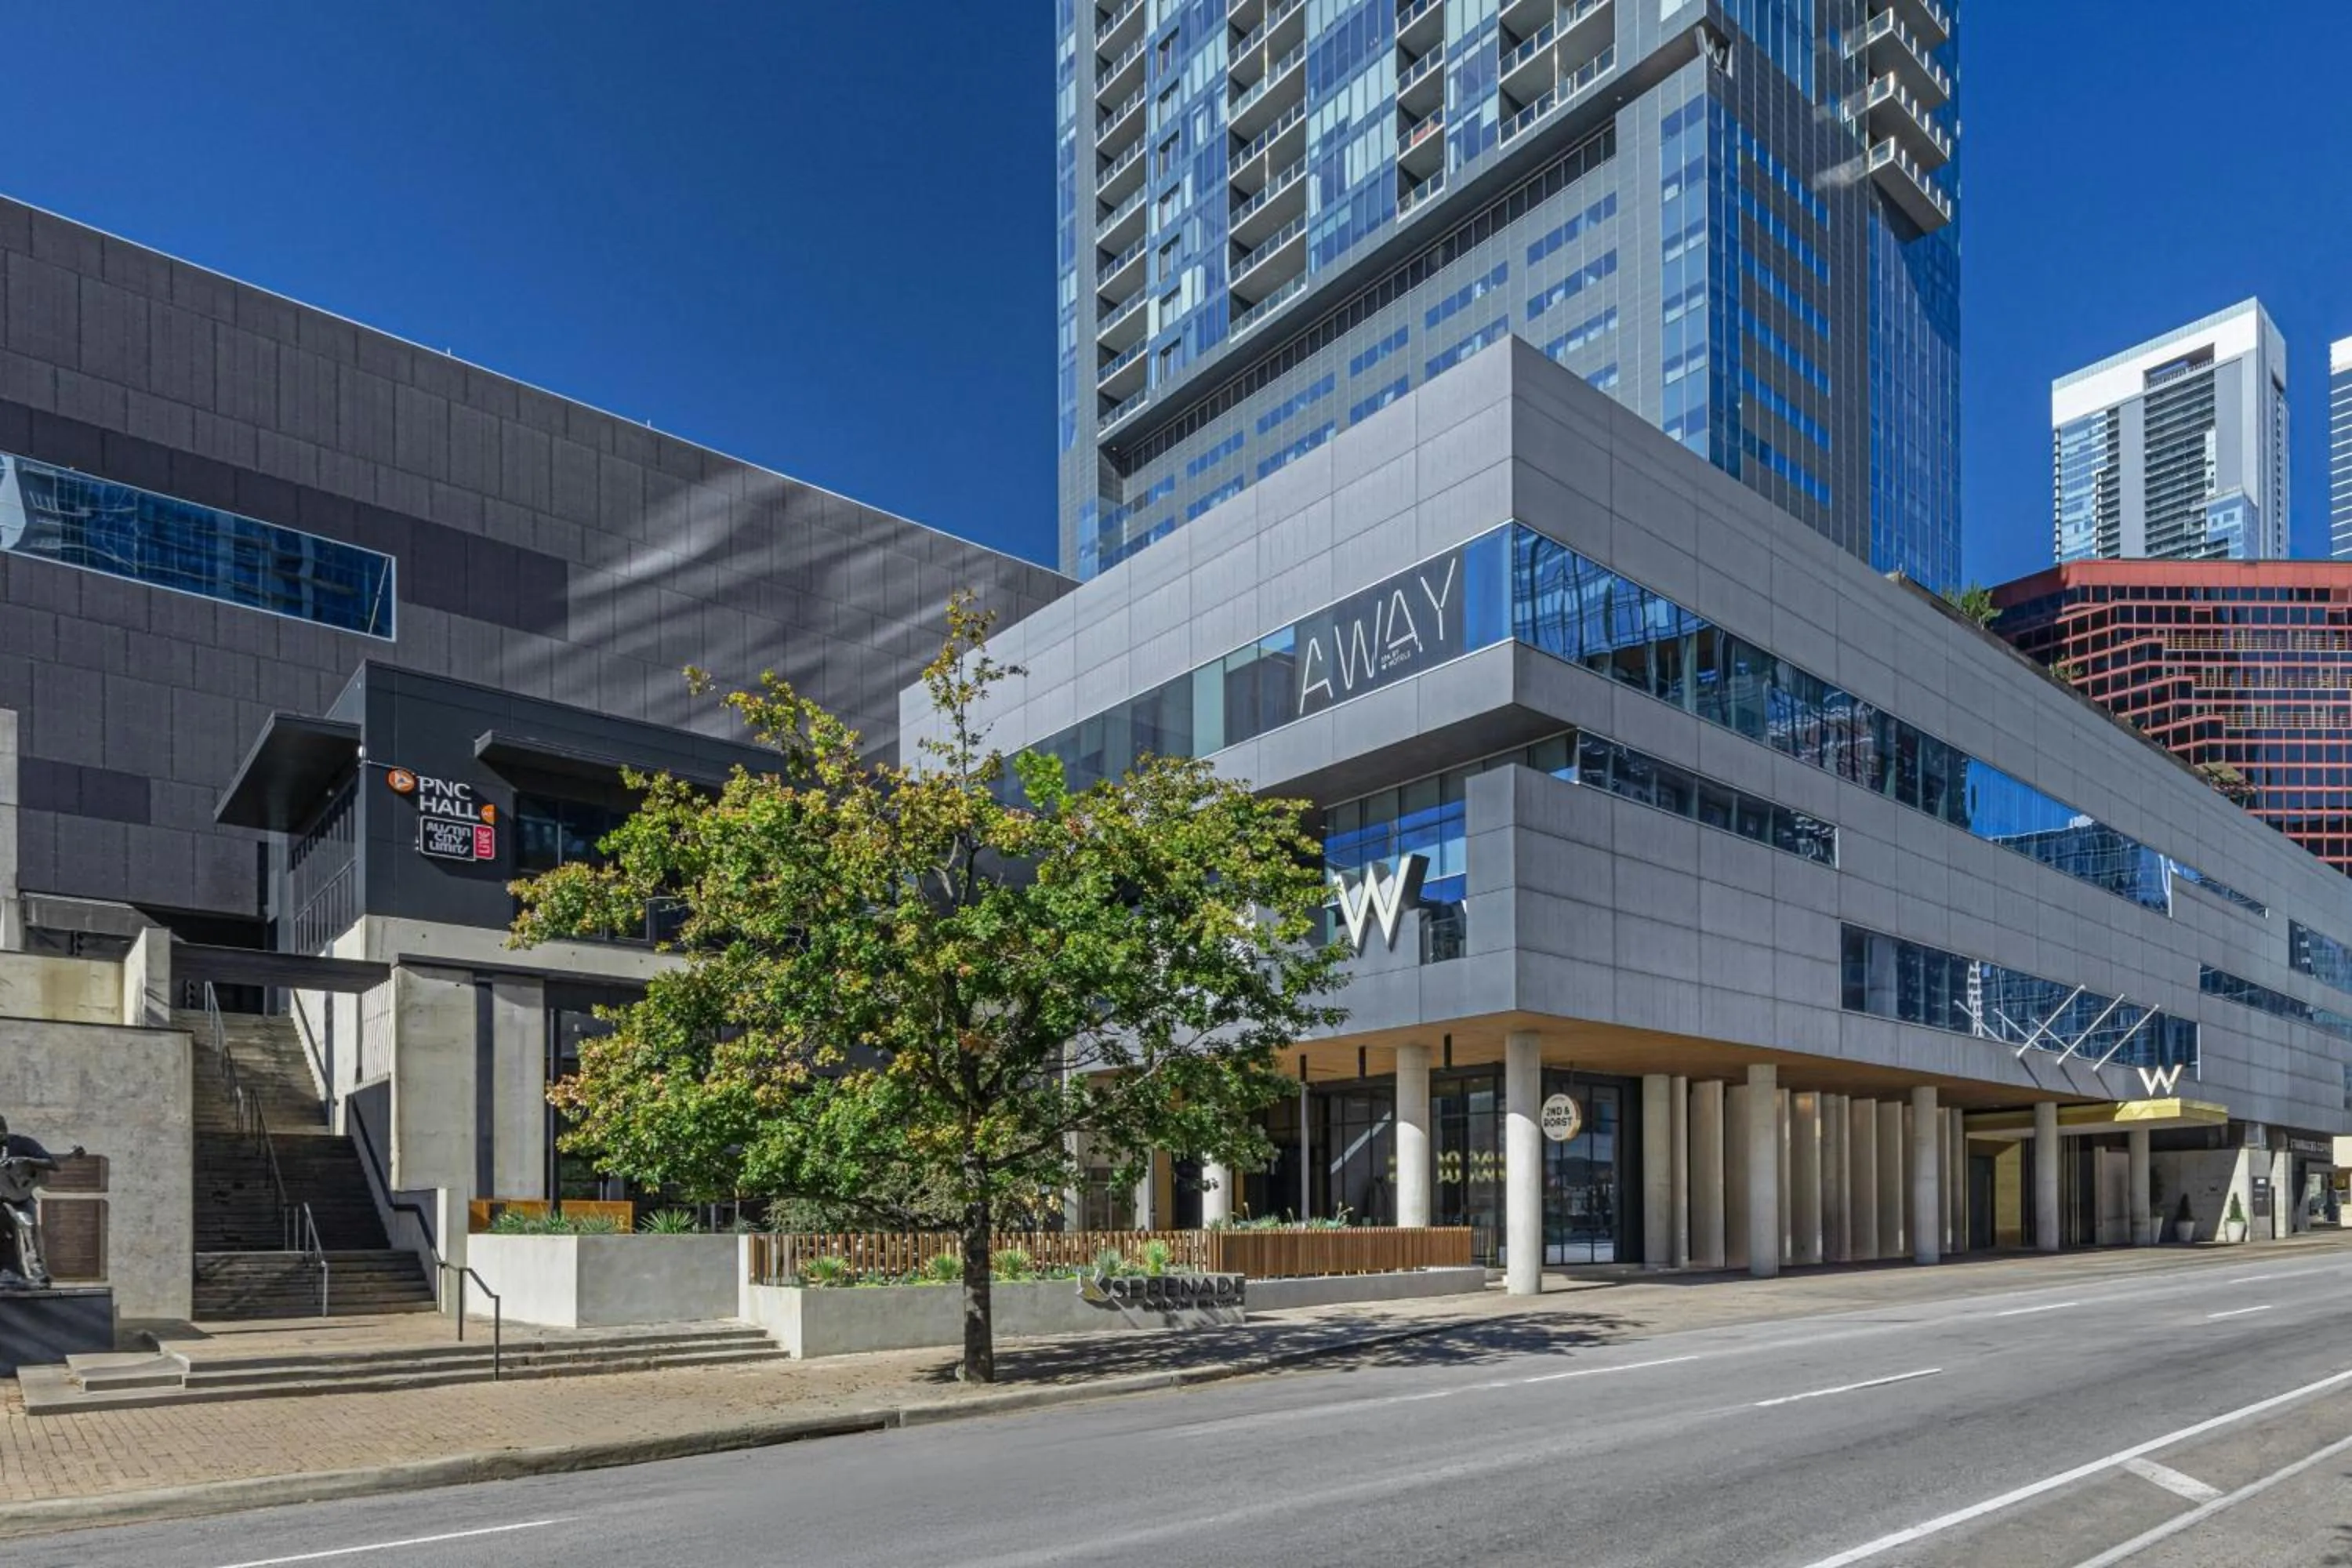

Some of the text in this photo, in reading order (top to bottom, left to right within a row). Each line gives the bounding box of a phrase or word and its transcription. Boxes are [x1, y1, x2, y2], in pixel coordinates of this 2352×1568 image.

[1298, 557, 1456, 716] AWAY
[419, 775, 471, 800] PNC
[419, 794, 481, 821] HALL
[1332, 852, 1417, 952] W
[2137, 1063, 2183, 1097] W
[1112, 1276, 1246, 1300] SERENADE
